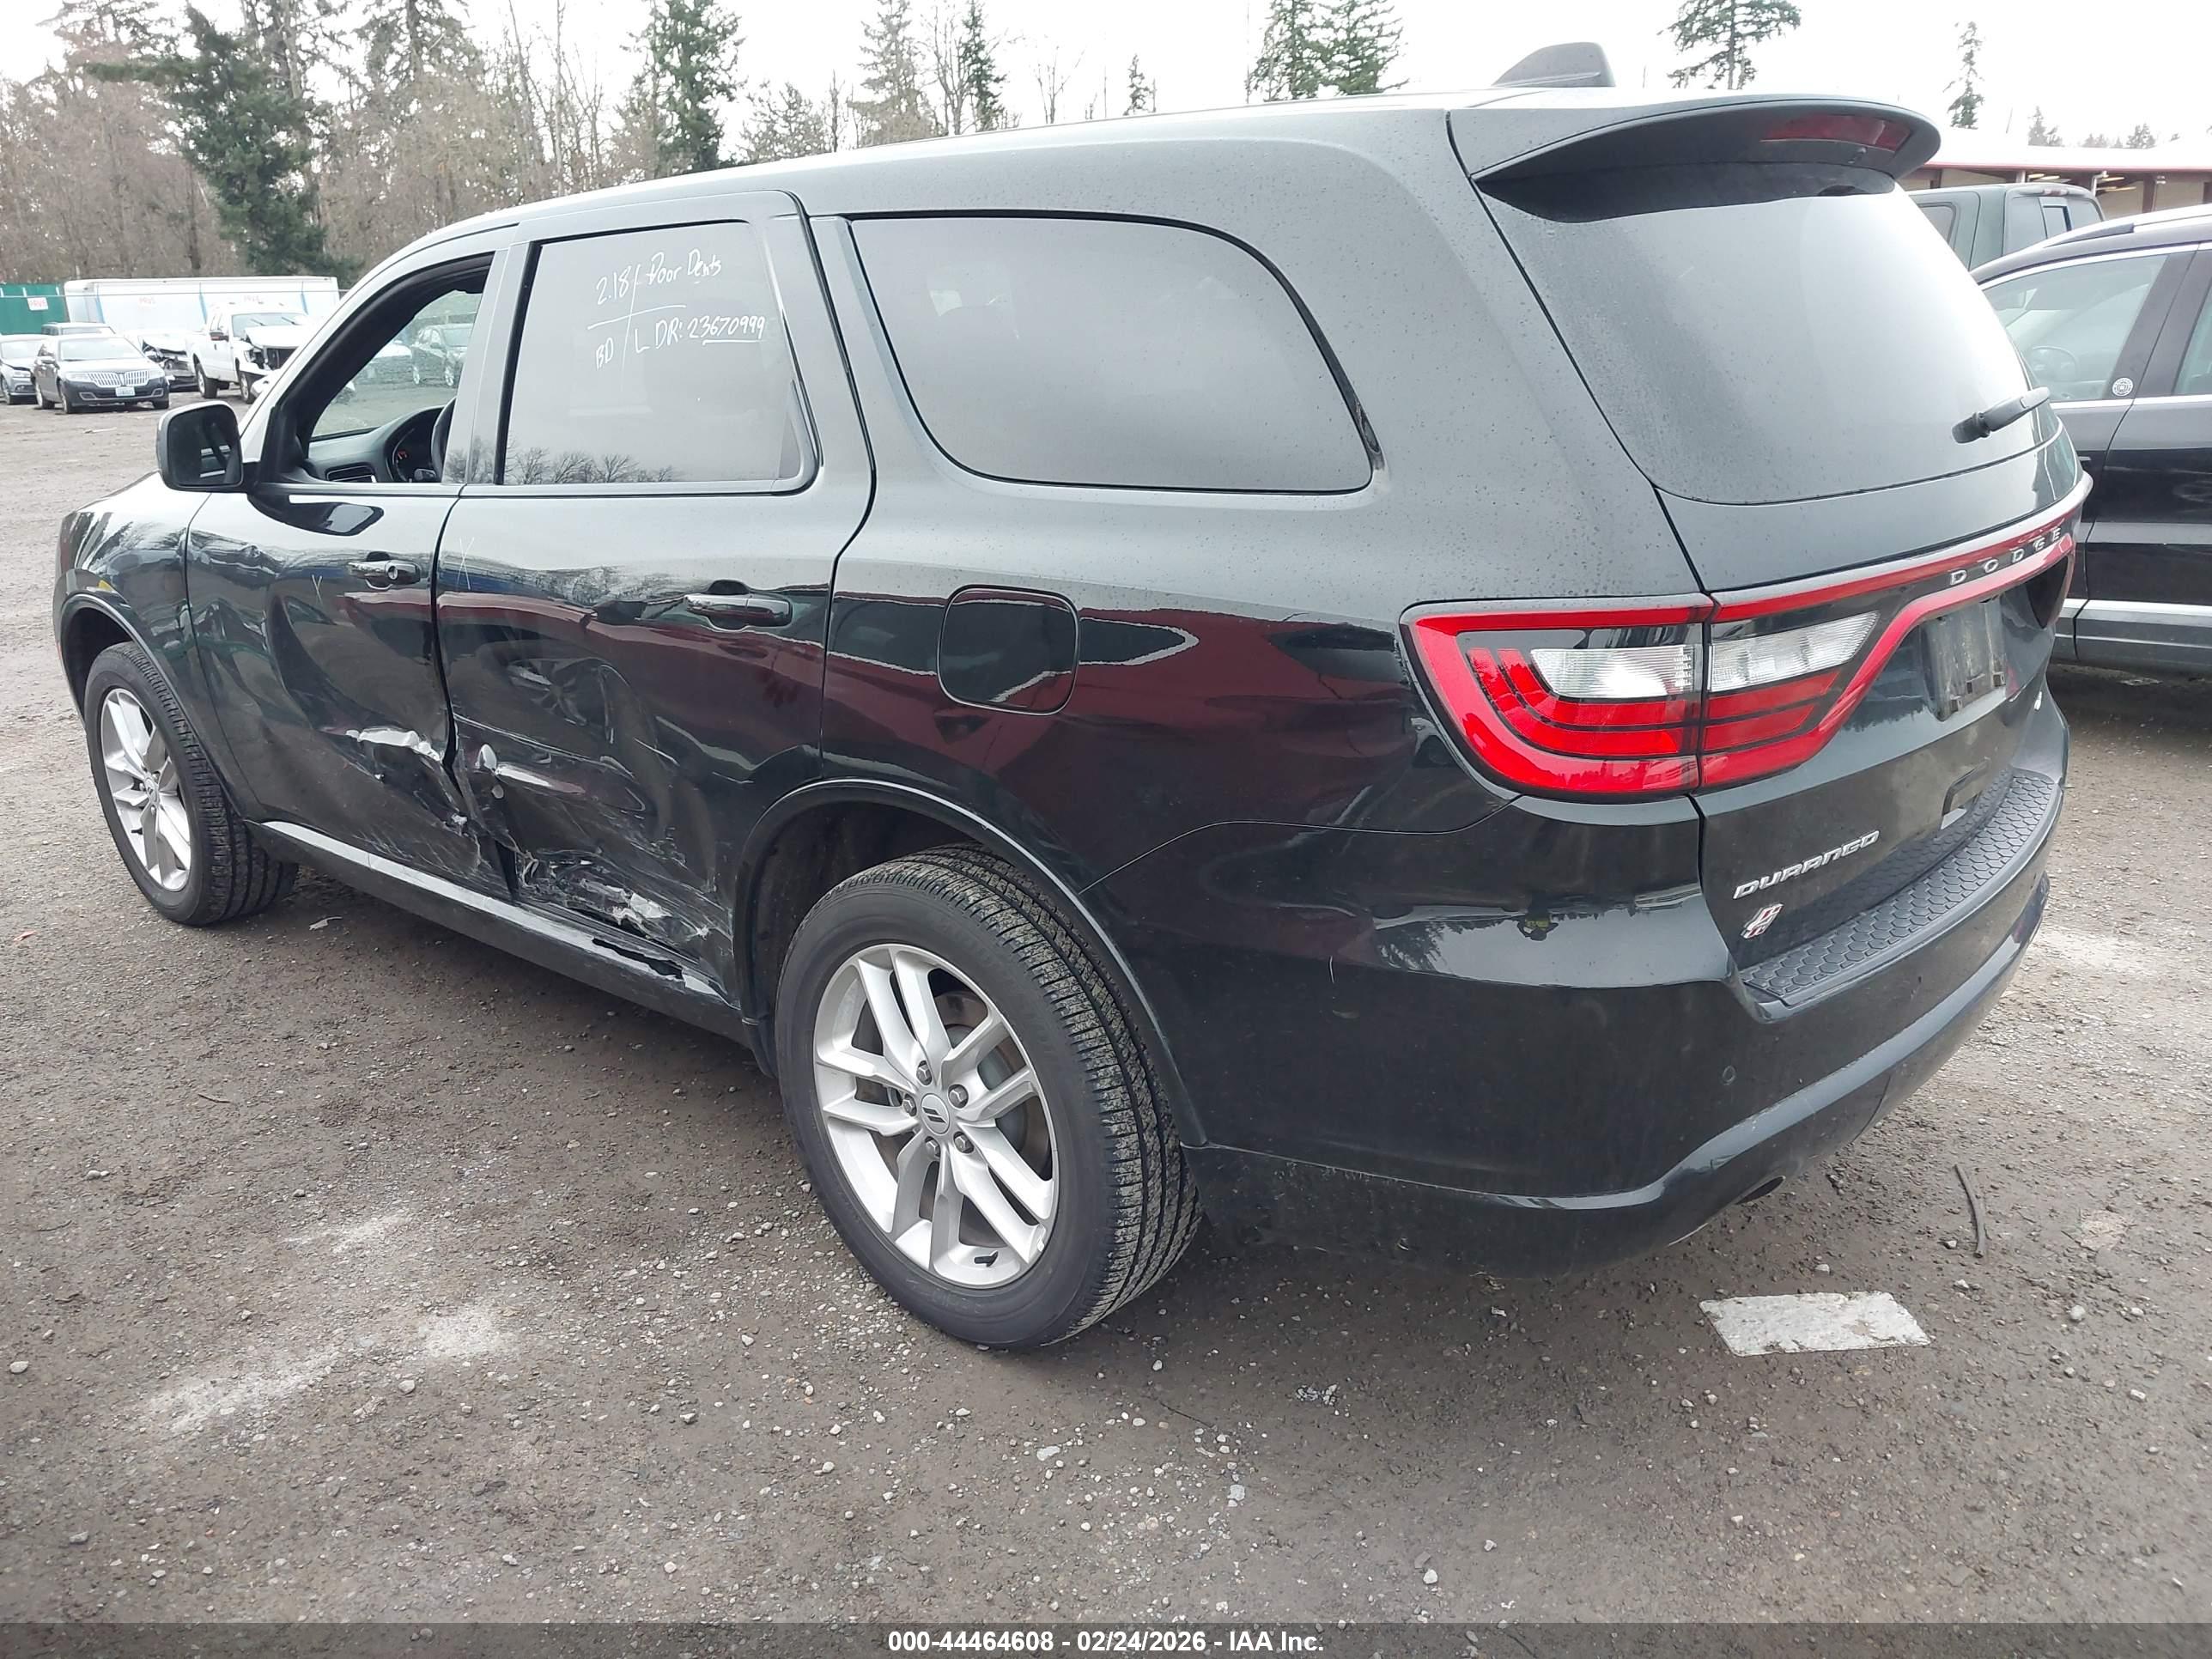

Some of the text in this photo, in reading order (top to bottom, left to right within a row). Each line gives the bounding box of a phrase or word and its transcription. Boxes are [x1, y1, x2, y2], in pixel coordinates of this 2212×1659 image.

[687, 248, 722, 277] Dents
[686, 315, 766, 340] 23670999
[1948, 526, 2062, 586] DODGE
[1731, 829, 1881, 901] DURANGO
